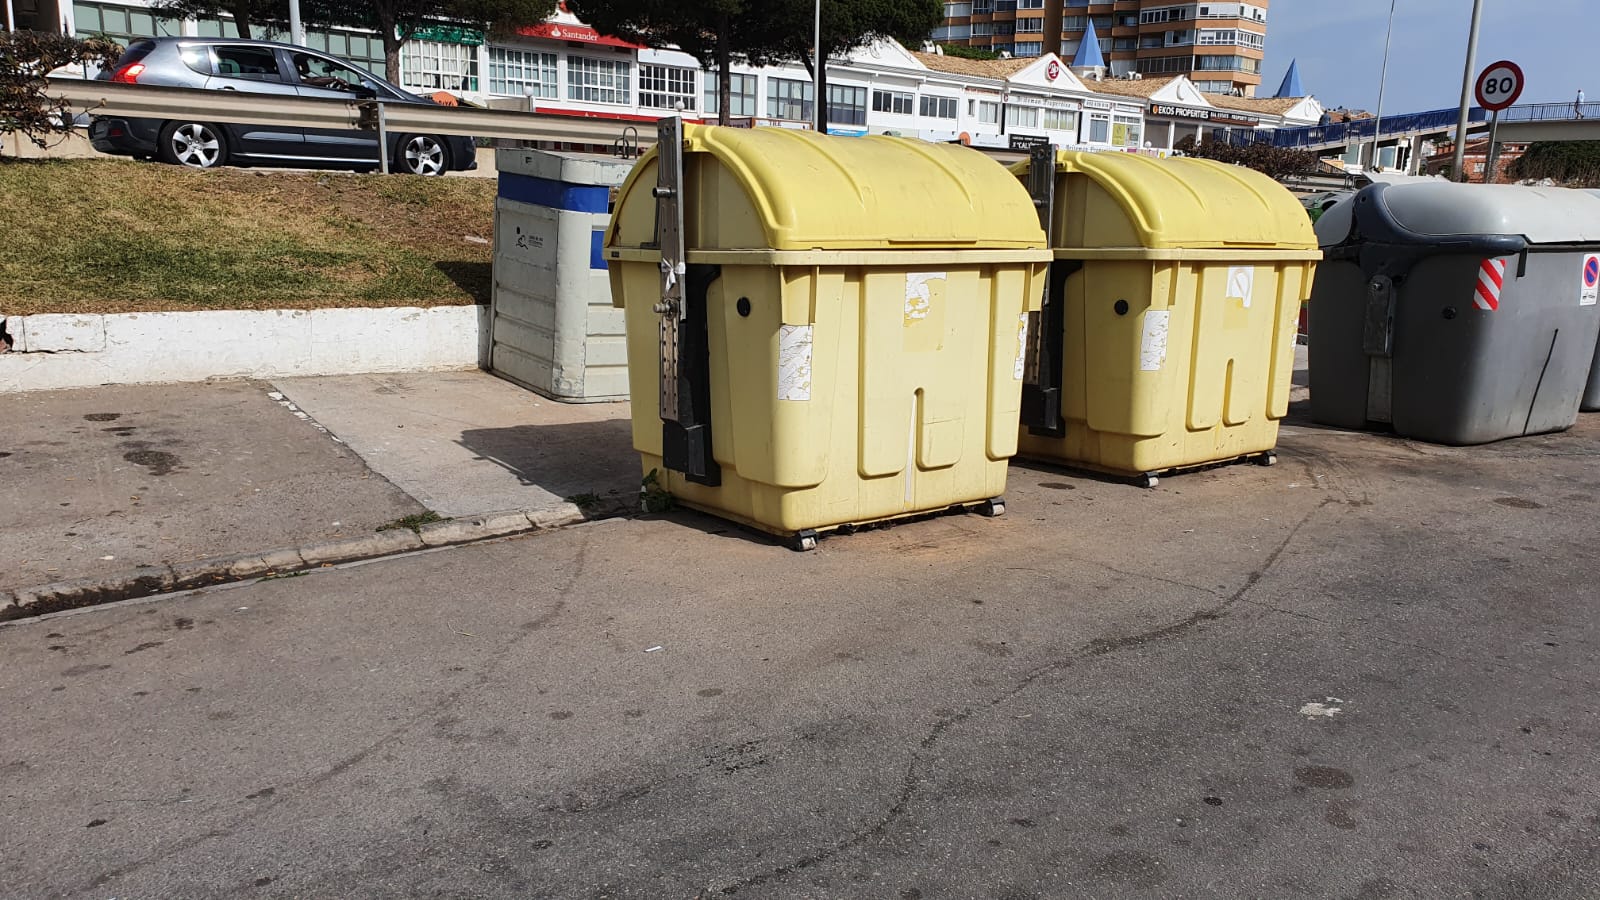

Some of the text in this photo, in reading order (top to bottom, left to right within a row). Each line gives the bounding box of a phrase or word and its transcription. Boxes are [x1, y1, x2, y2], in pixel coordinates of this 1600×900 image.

[562, 29, 598, 41] Santander
[1485, 77, 1513, 94] 80
[1158, 106, 1174, 115] EKOS
[1175, 108, 1209, 119] PROPERTIES
